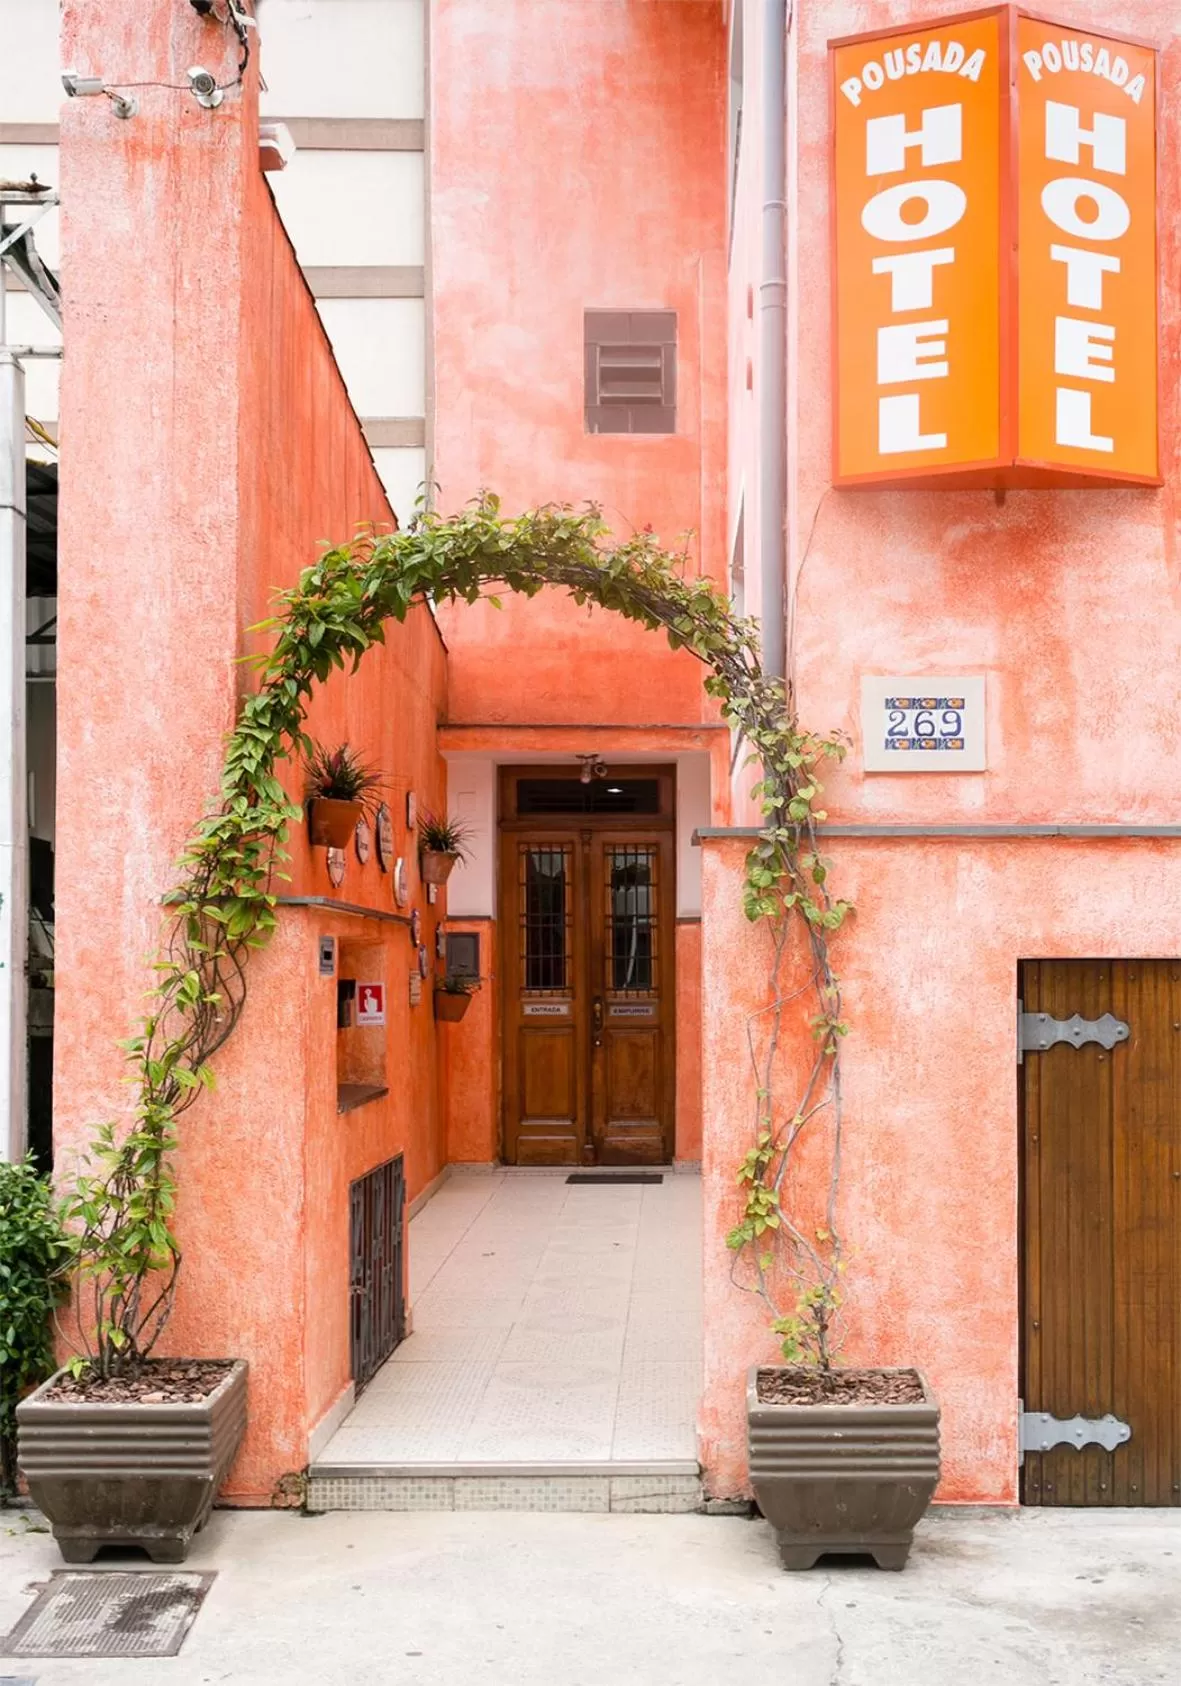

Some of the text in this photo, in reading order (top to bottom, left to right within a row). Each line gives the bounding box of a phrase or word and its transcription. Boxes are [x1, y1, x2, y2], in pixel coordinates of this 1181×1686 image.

[840, 41, 986, 107] POUSADA
[1022, 40, 1146, 104] POUSADA
[861, 103, 967, 454] HOTEL
[1041, 100, 1131, 453] HOTEL
[887, 710, 962, 737] 269
